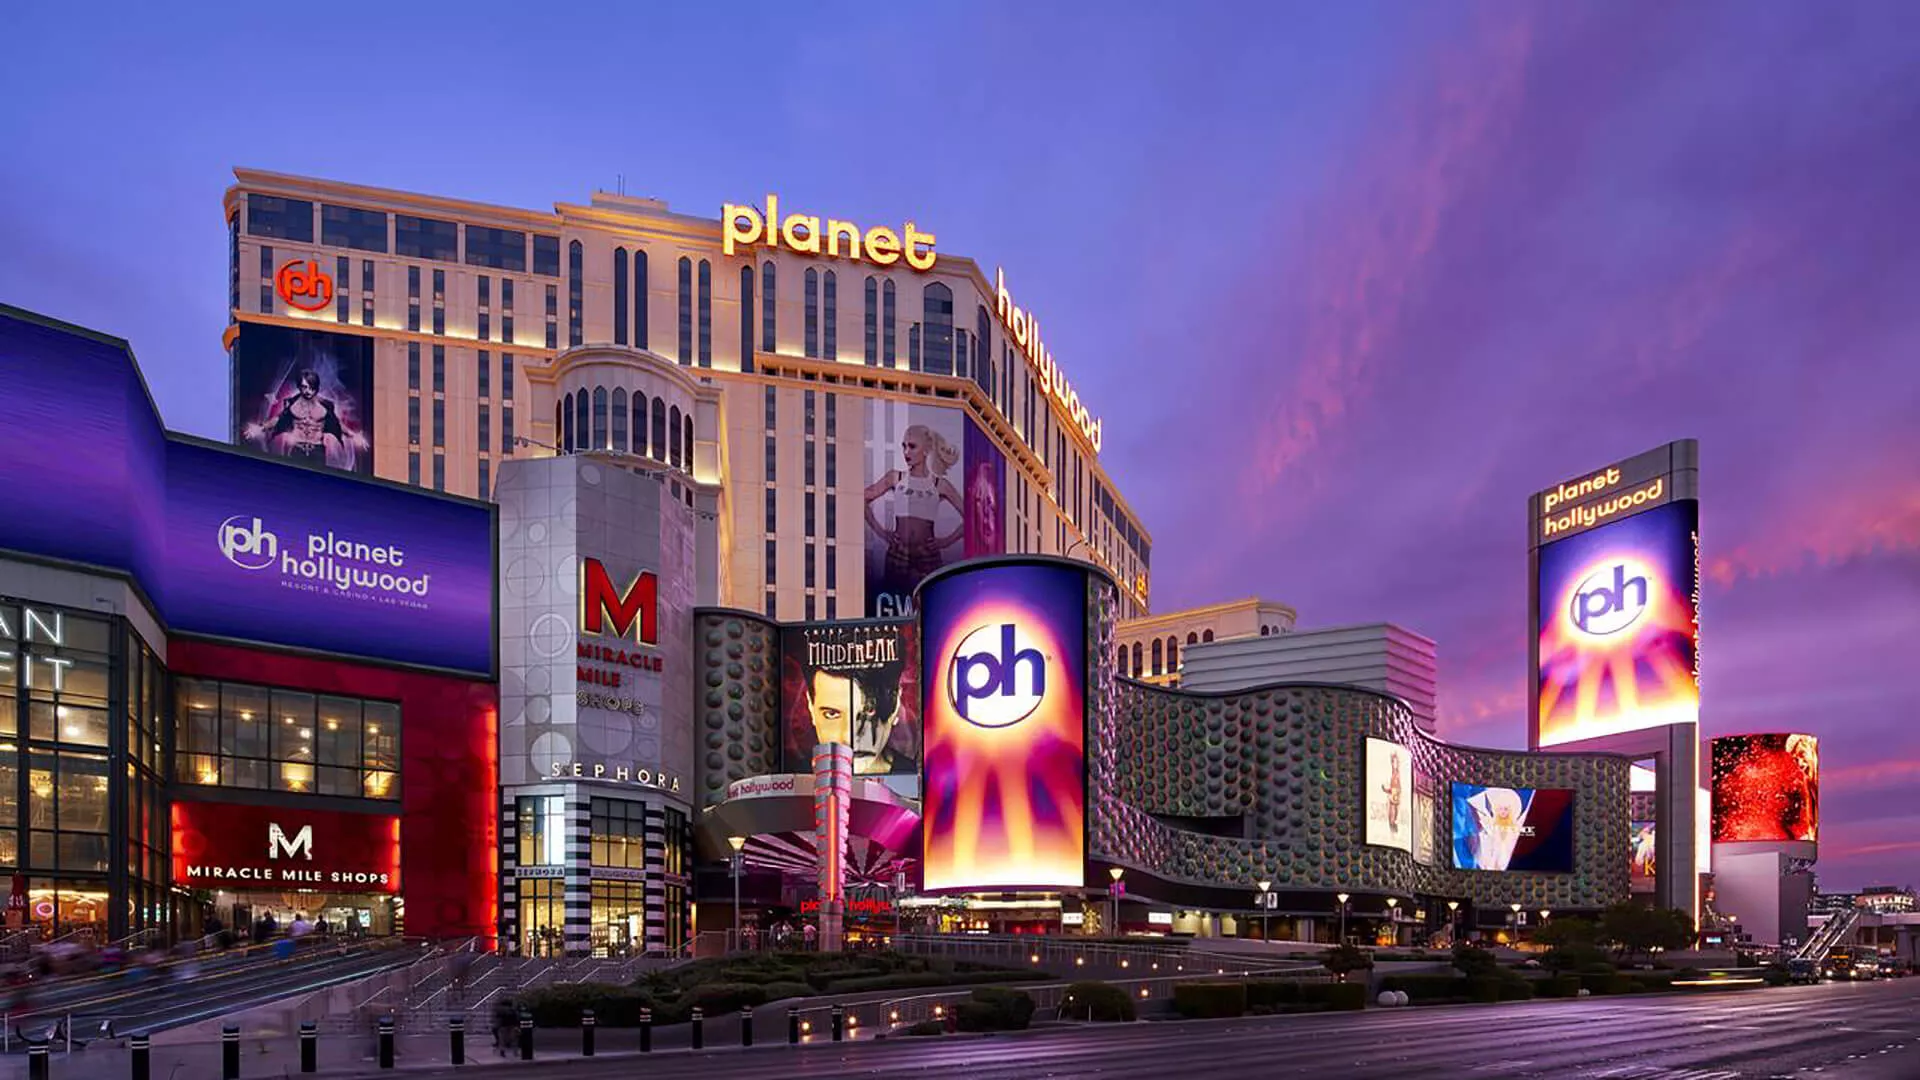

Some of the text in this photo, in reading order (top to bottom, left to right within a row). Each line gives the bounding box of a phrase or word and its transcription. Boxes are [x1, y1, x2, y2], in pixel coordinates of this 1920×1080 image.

[722, 193, 937, 272] planet
[280, 259, 332, 306] ph
[997, 266, 1102, 453] hollywood
[1544, 468, 1621, 514] planet
[1544, 478, 1664, 536] hollywood
[221, 517, 278, 564] ph
[308, 531, 404, 567] planet
[281, 550, 430, 596] hollywood
[281, 580, 320, 592] RESORT
[334, 588, 369, 601] CASINO
[581, 557, 658, 647] M
[1576, 564, 1648, 633] ph
[576, 641, 663, 672] MIRACLE
[808, 638, 899, 666] MINDFREAK
[952, 623, 1046, 723] ph
[576, 665, 621, 688] MILE
[576, 689, 644, 716] SHOPS
[551, 762, 680, 793] SEPHORA
[268, 822, 313, 861] M
[186, 865, 389, 884] MIRACLE MILE SHOPS
